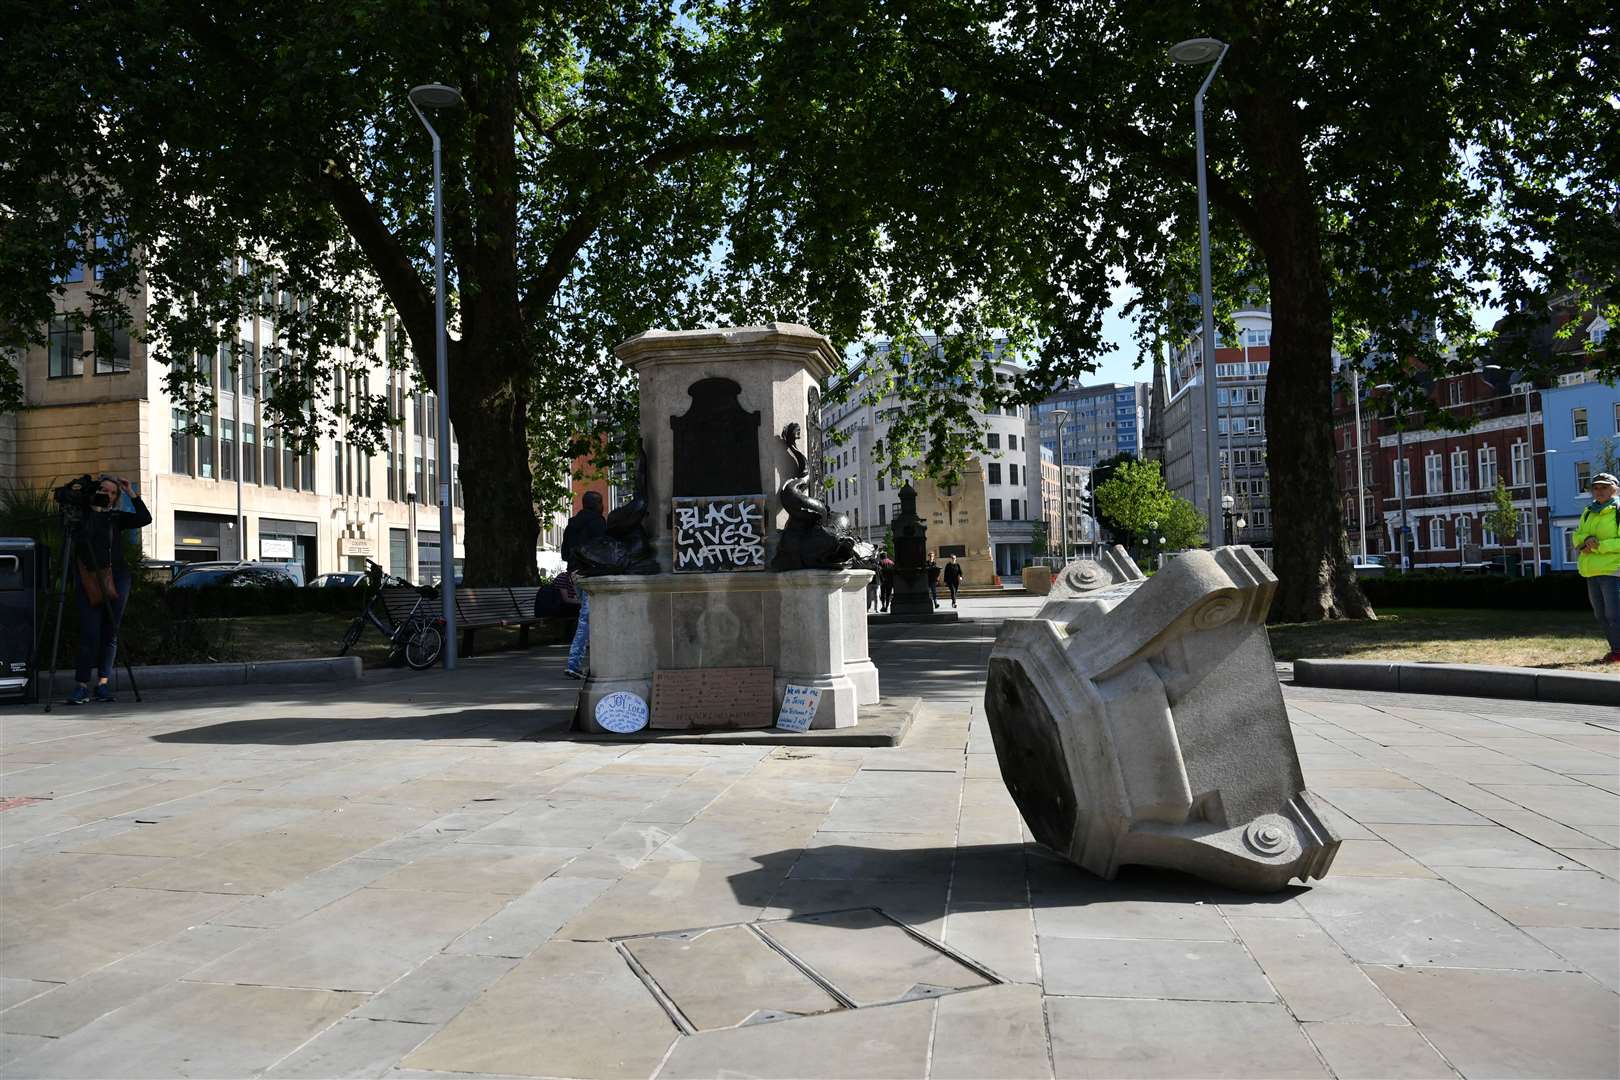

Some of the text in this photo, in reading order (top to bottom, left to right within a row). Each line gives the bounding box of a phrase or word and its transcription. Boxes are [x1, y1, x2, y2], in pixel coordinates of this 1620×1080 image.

[676, 501, 763, 529] BLACK
[678, 544, 765, 567] MATTER
[609, 695, 628, 709] JOY
